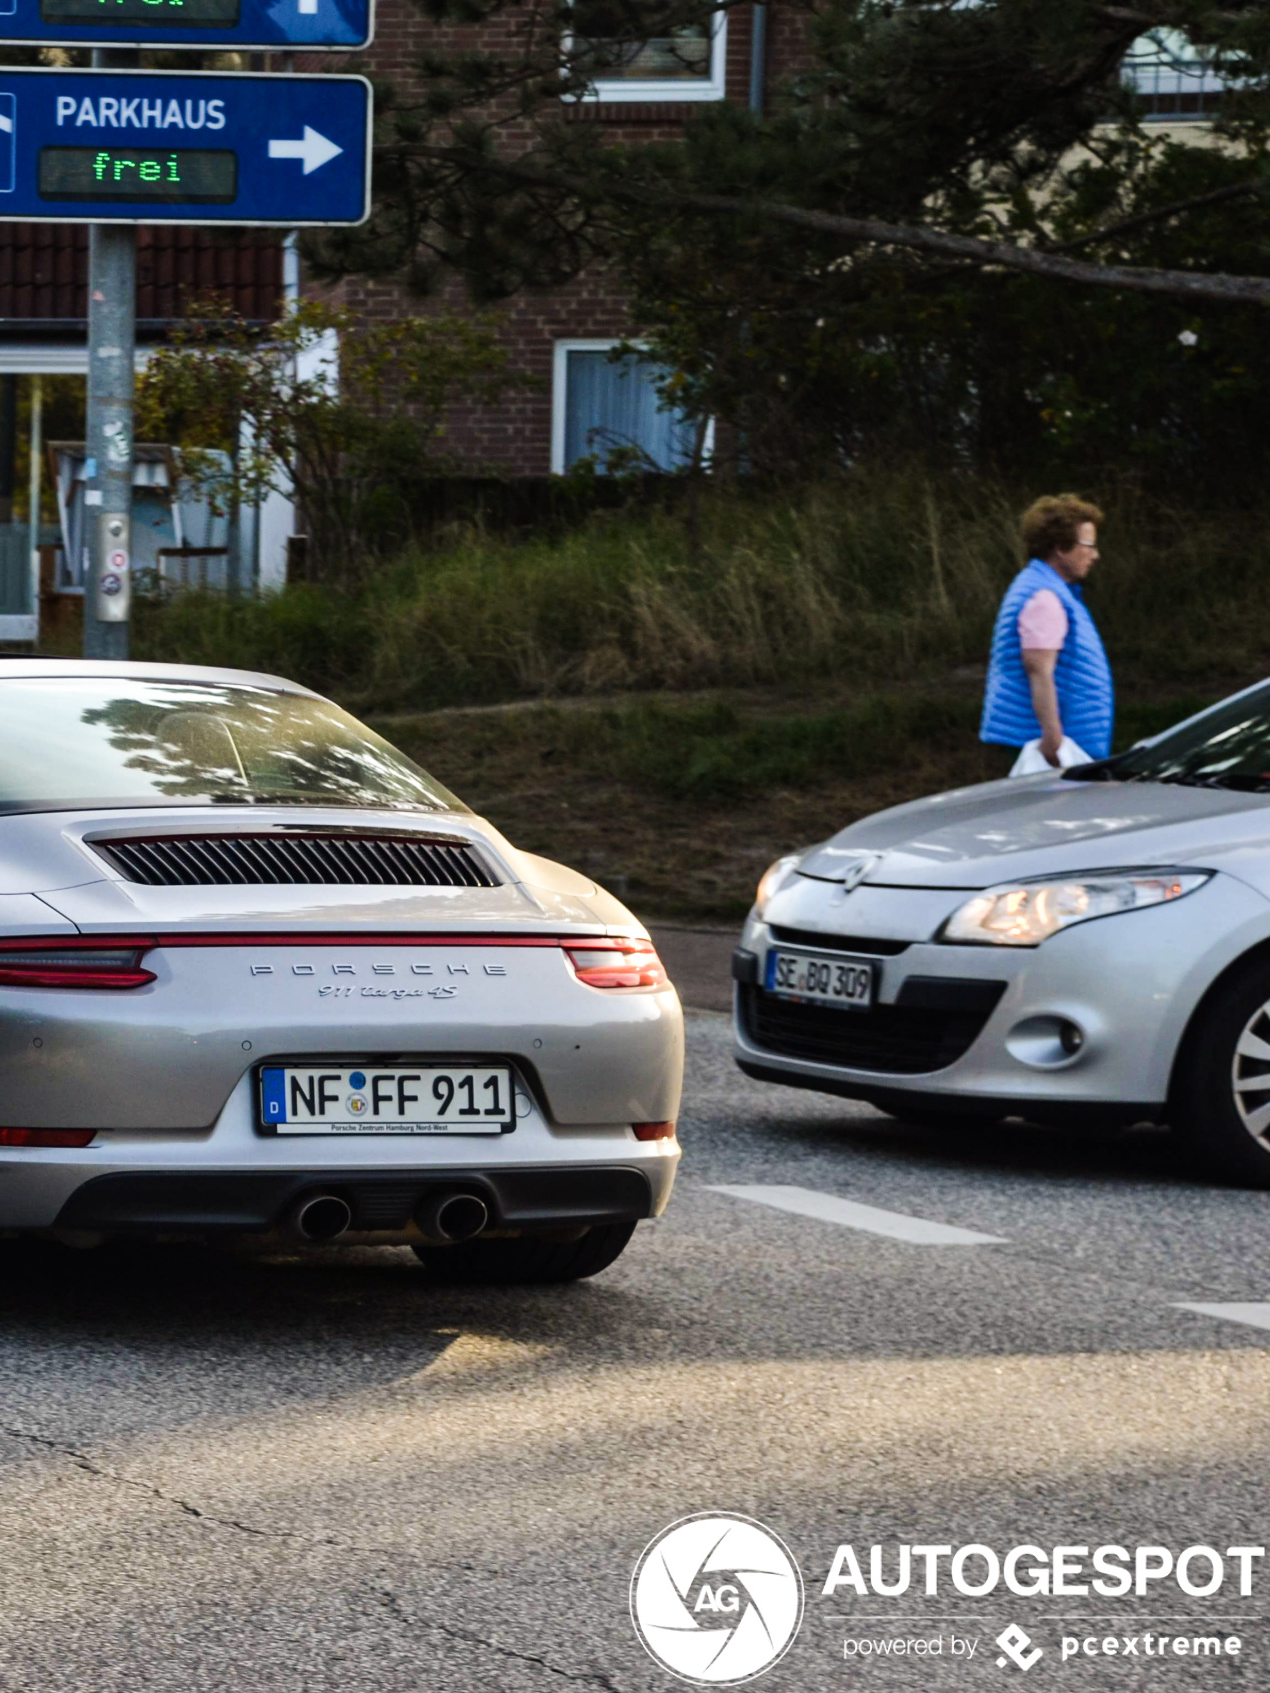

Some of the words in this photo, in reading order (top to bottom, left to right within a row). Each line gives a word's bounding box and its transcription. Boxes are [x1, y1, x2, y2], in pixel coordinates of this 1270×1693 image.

[56, 96, 226, 130] PARKHAUS
[92, 152, 181, 182] frei
[250, 963, 508, 976] PORSCHE
[775, 957, 798, 988] SE
[807, 962, 830, 994] BQ
[833, 966, 870, 999] 309
[318, 984, 355, 998] 911
[427, 985, 459, 1000] 4S
[290, 1074, 342, 1117] NF
[371, 1074, 421, 1117] FF
[431, 1074, 506, 1117] 911
[270, 1102, 279, 1114] D
[331, 1124, 357, 1132] Porsche
[358, 1124, 385, 1132] Zentrum
[386, 1124, 415, 1133] Hamburg
